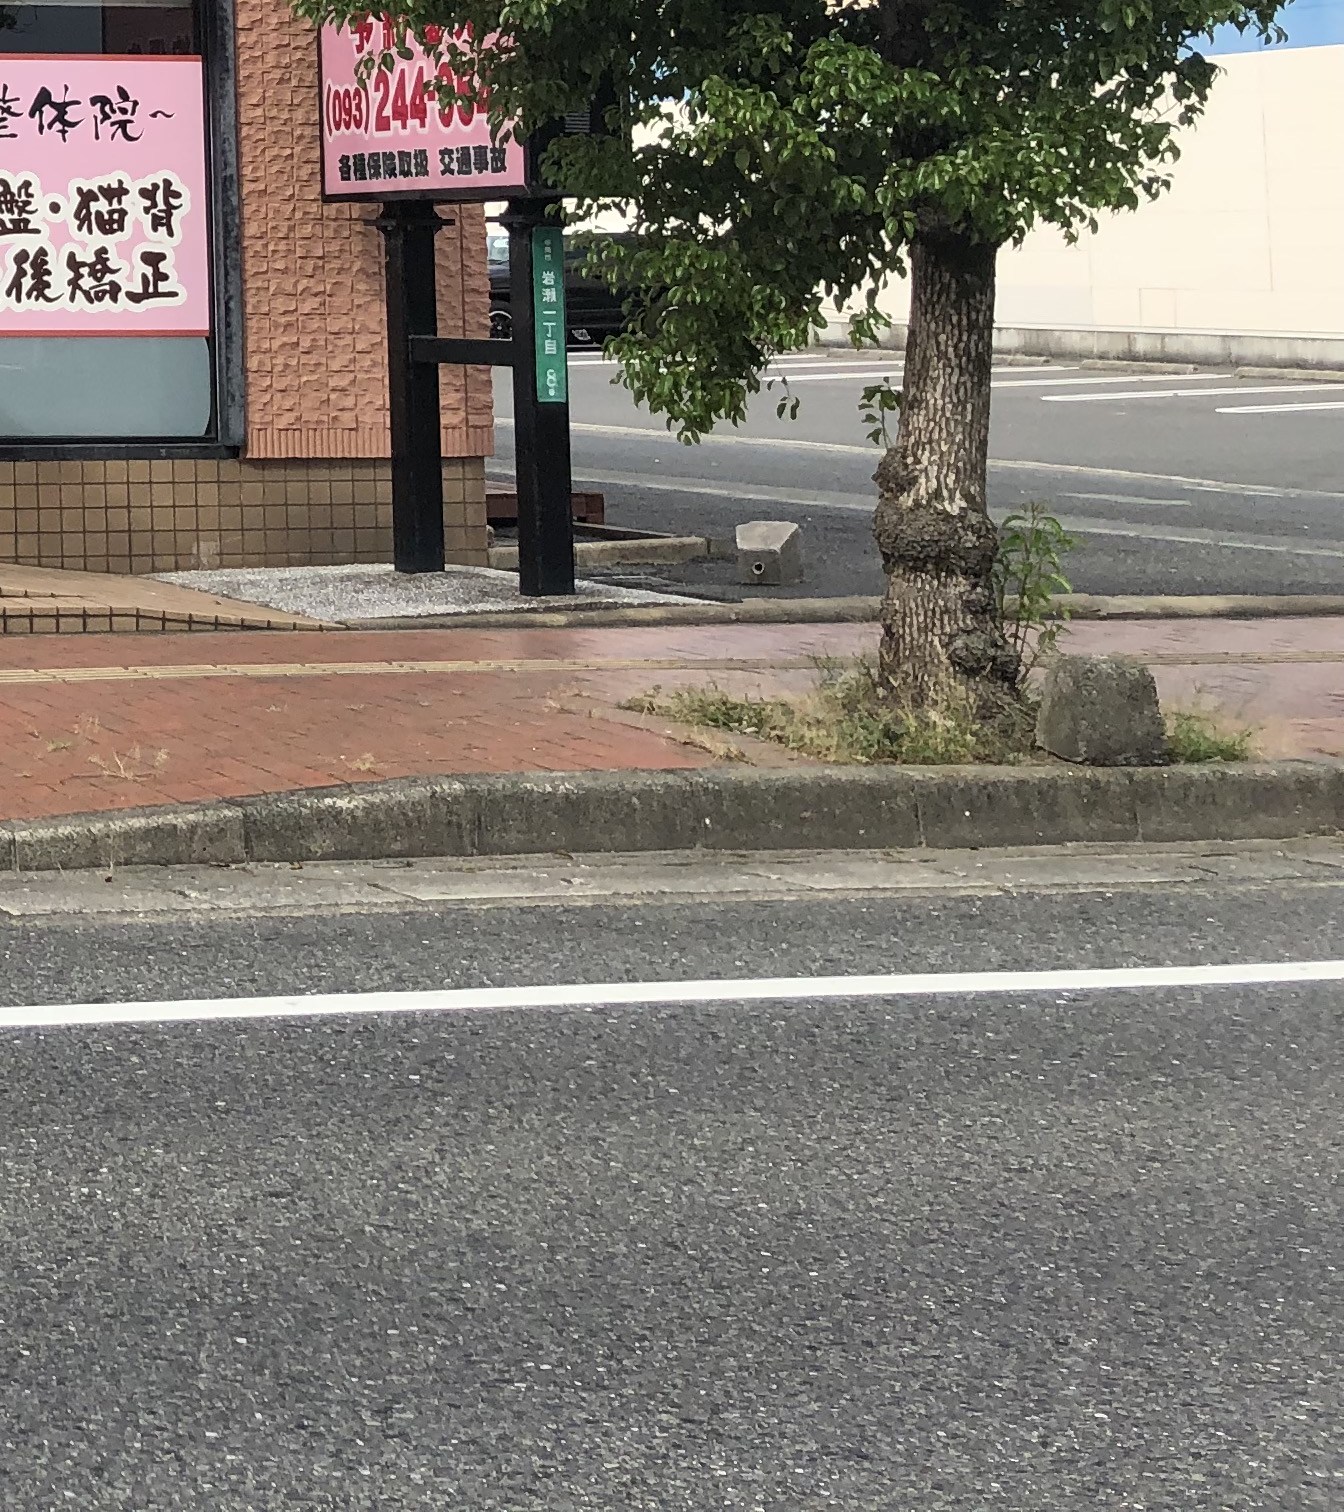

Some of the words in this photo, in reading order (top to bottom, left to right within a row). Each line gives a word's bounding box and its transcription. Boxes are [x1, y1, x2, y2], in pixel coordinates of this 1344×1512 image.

[338, 149, 429, 181] 各種保険取扱
[438, 145, 507, 176] 交通事故
